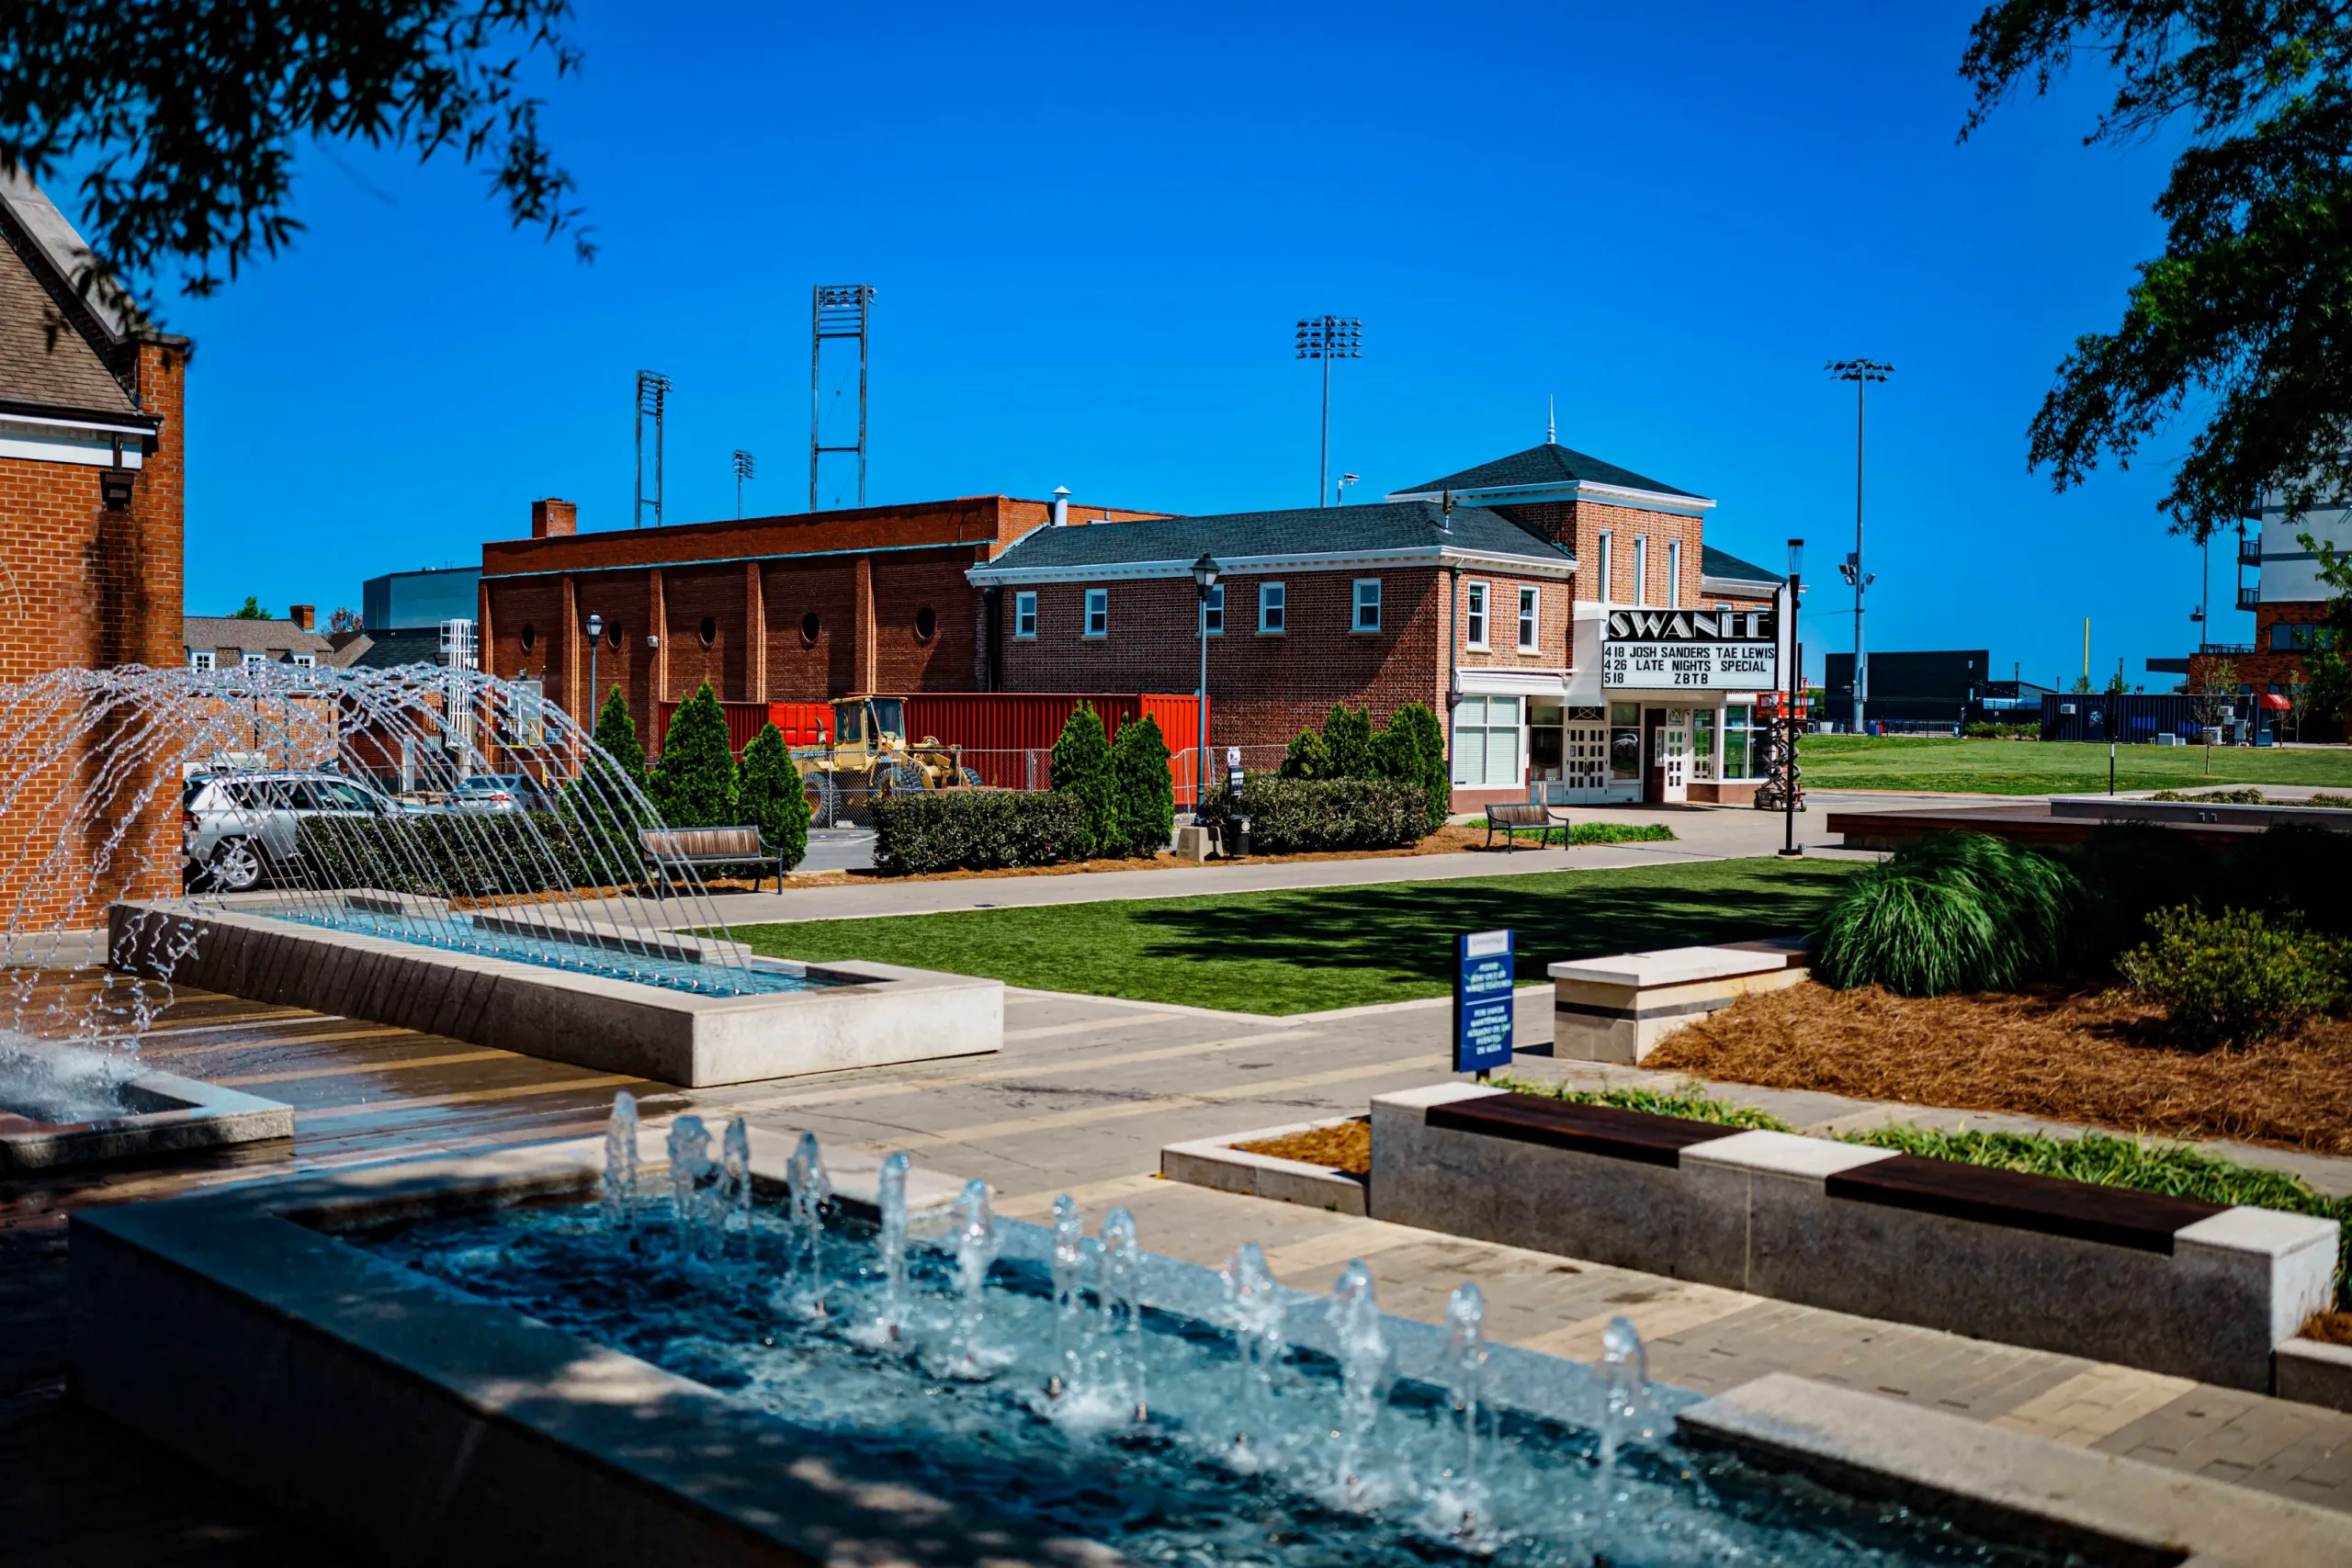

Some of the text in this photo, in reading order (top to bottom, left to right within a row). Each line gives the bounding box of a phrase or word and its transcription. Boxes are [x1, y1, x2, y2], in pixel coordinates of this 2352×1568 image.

[1610, 612, 1770, 638] SWANEE
[1604, 647, 1775, 660] 4 18 JOSH SANDERS TAE LEWIS
[1604, 660, 1767, 672] 4 26 LATE NIGHTS SPECIAL
[1613, 672, 1624, 683] 18
[1674, 672, 1709, 684] ZBTB
